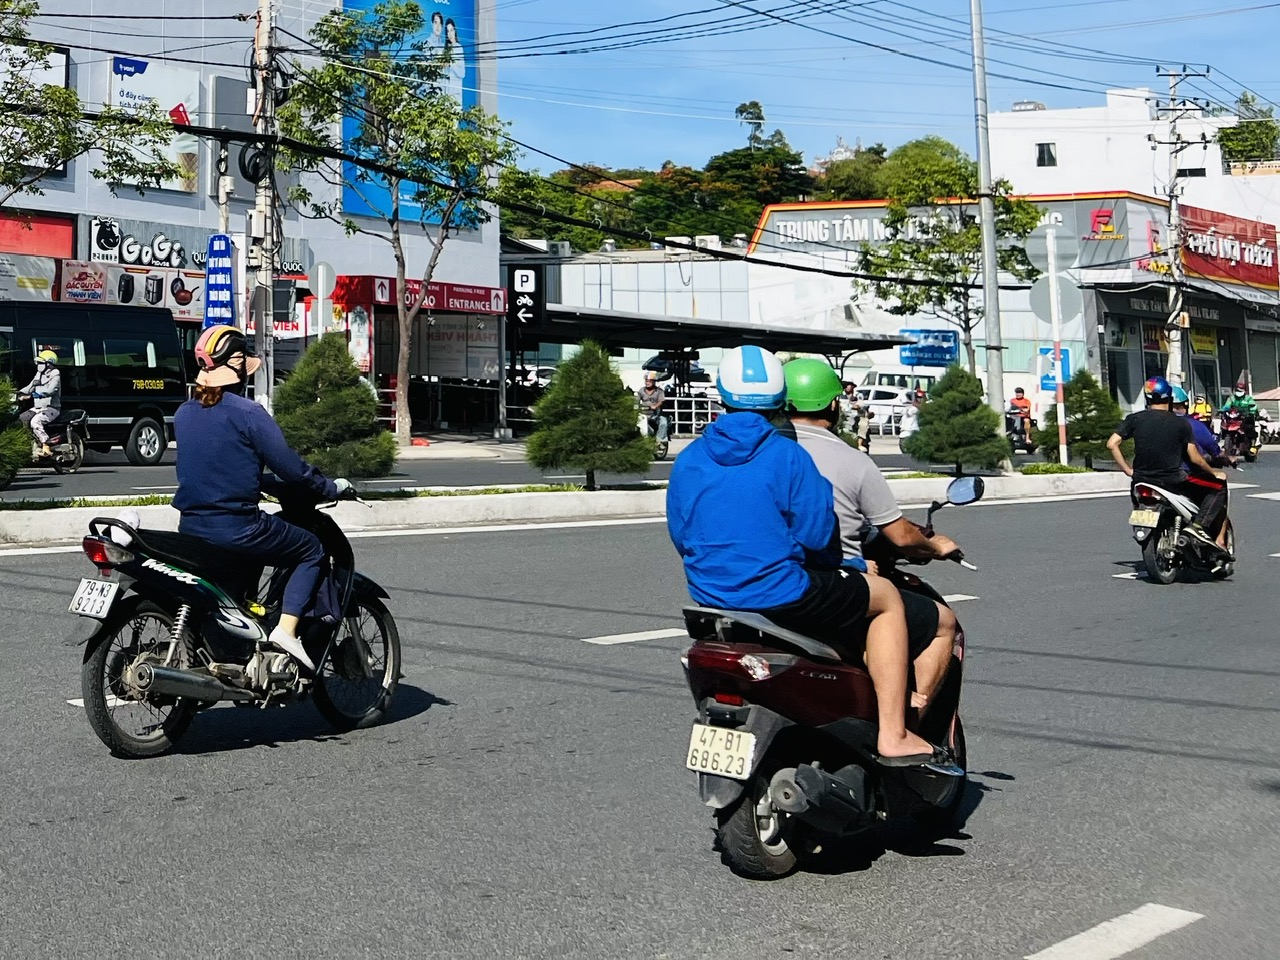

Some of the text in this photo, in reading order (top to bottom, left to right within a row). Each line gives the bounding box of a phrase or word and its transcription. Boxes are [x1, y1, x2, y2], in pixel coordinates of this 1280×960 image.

[776, 219, 830, 244] TRUNG
[832, 214, 870, 242] TÂM
[449, 298, 491, 311] ENTRANCE
[82, 580, 112, 598] 79-N3
[74, 596, 105, 614] 9213
[699, 727, 743, 753] 47-B1
[689, 748, 745, 776] 686.23
